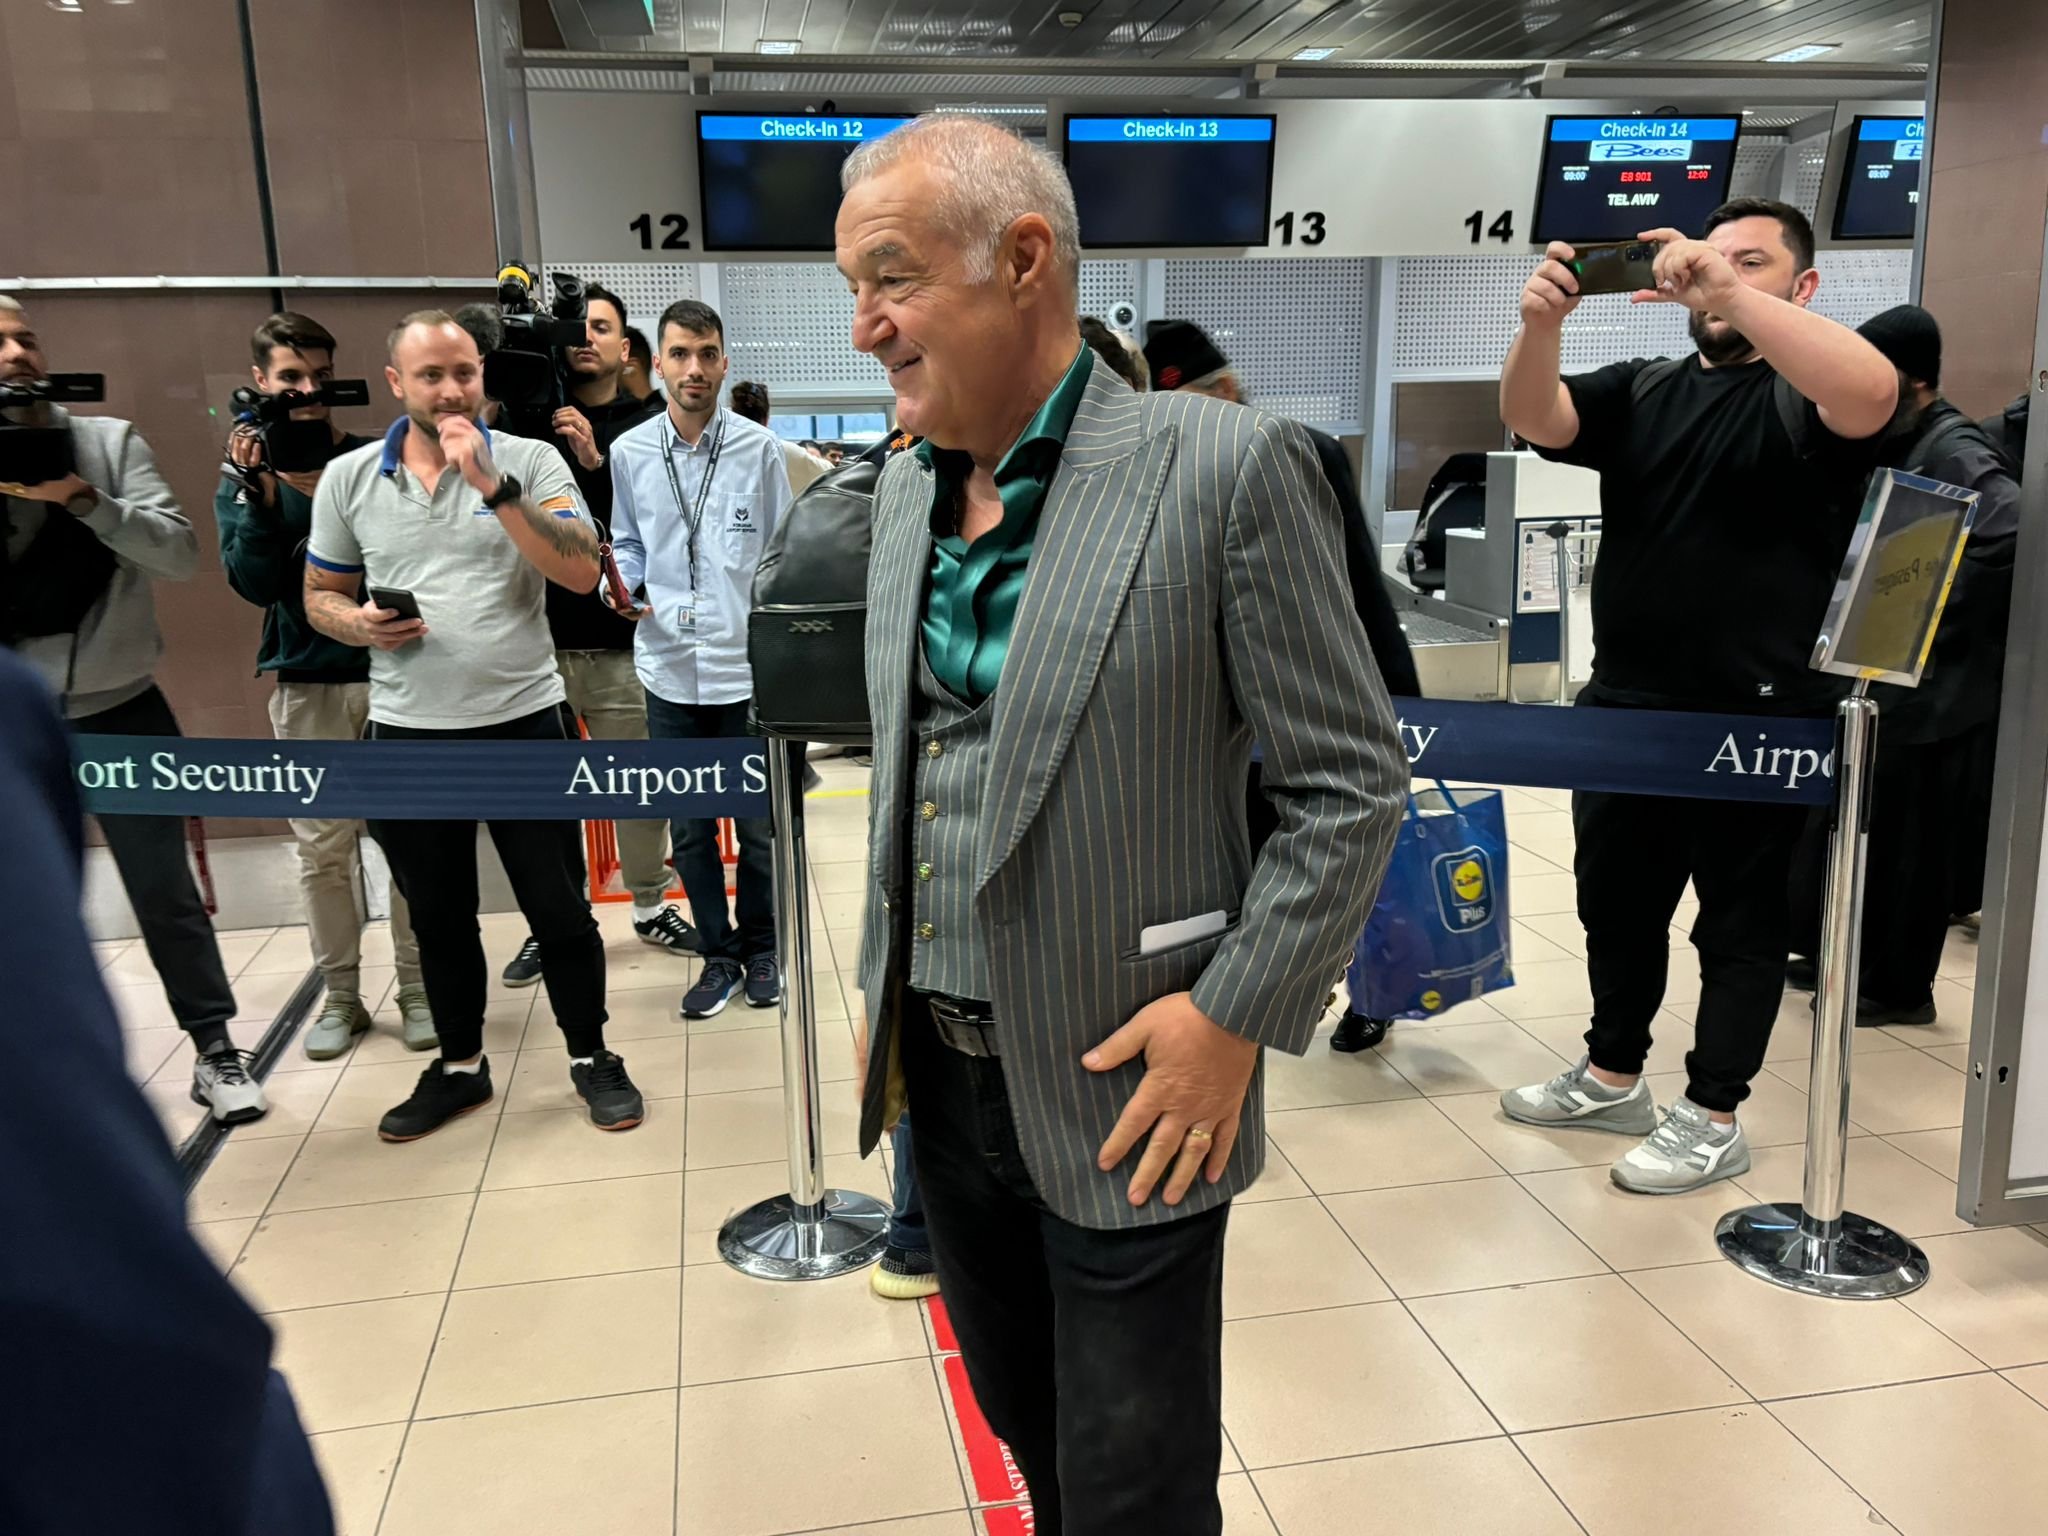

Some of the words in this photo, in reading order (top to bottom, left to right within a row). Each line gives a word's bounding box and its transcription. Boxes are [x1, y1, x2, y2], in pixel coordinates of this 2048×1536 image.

[760, 119, 838, 138] Check-In
[842, 120, 863, 138] 12
[1123, 120, 1194, 138] Check-In
[1198, 120, 1219, 138] 13
[1600, 122, 1666, 138] Check-In
[1669, 122, 1688, 137] 14
[1596, 142, 1687, 159] Bees
[1635, 171, 1652, 182] 901
[1607, 193, 1630, 206] TEL
[1631, 193, 1660, 206] AVIV
[629, 213, 690, 250] 12
[1273, 211, 1326, 246] 13
[1464, 210, 1514, 243] 14
[151, 752, 326, 804] Security
[564, 755, 728, 806] Airport
[742, 754, 767, 793] S
